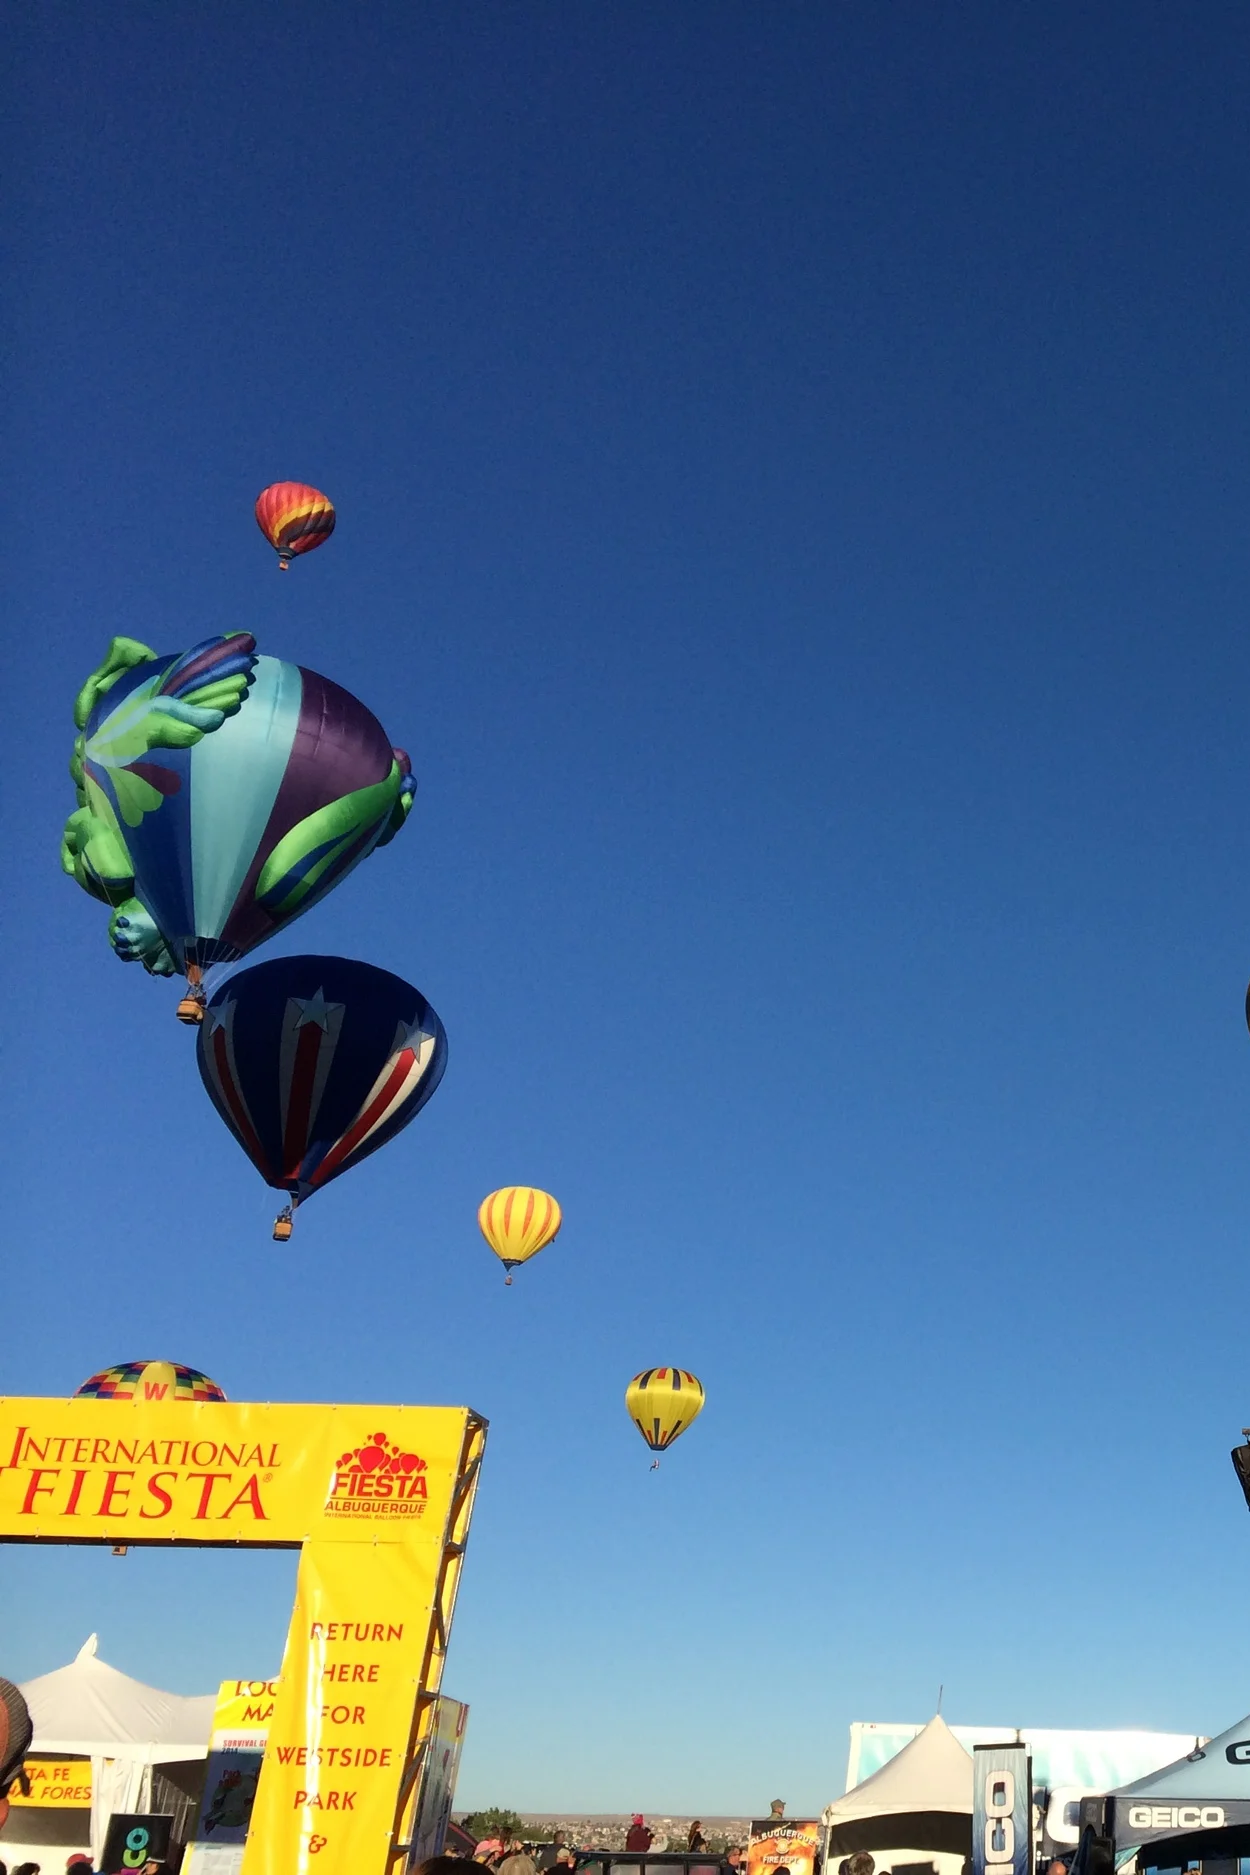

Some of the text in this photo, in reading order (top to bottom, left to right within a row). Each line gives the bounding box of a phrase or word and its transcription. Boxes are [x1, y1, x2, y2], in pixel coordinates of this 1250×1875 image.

[145, 1382, 169, 1400] W
[8, 1427, 281, 1468] INTERNATIONAL
[17, 1468, 271, 1520] FIESTA
[331, 1473, 428, 1499] FIESTA
[324, 1501, 426, 1514] ALBUQUERQUE
[311, 1623, 403, 1641] RETURN
[321, 1664, 380, 1682] HERE
[320, 1706, 365, 1724] FOR
[223, 1739, 257, 1748] SURVIVAL
[277, 1747, 392, 1767] WESTSIDE
[53, 1768, 70, 1780] FE
[41, 1786, 93, 1800] FORES
[294, 1791, 357, 1810] PARK
[1129, 1806, 1224, 1828] GEICO
[308, 1835, 327, 1853] &
[751, 1828, 815, 1847] ALBUQUERQUE
[763, 1855, 779, 1864] FIRE
